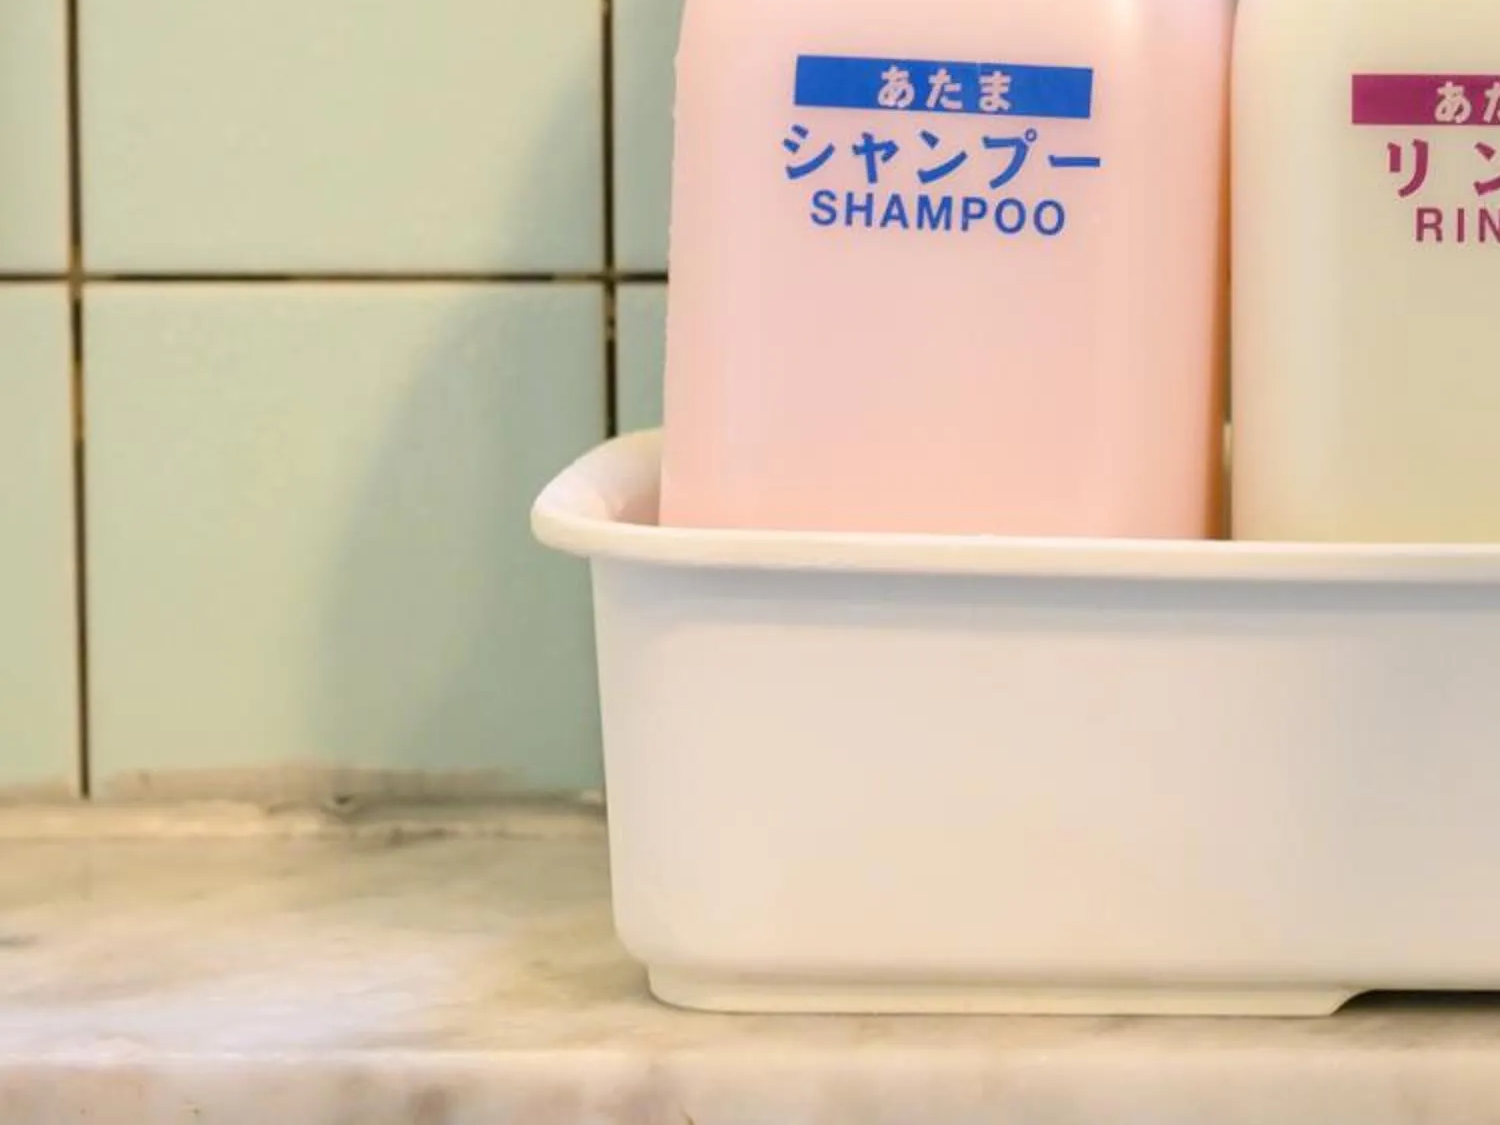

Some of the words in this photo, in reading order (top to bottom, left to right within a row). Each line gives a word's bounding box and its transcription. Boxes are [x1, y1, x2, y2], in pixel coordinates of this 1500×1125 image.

[877, 65, 1013, 111] あたま
[782, 124, 1101, 189] シャンプー
[810, 188, 1066, 236] SHAMPOO
